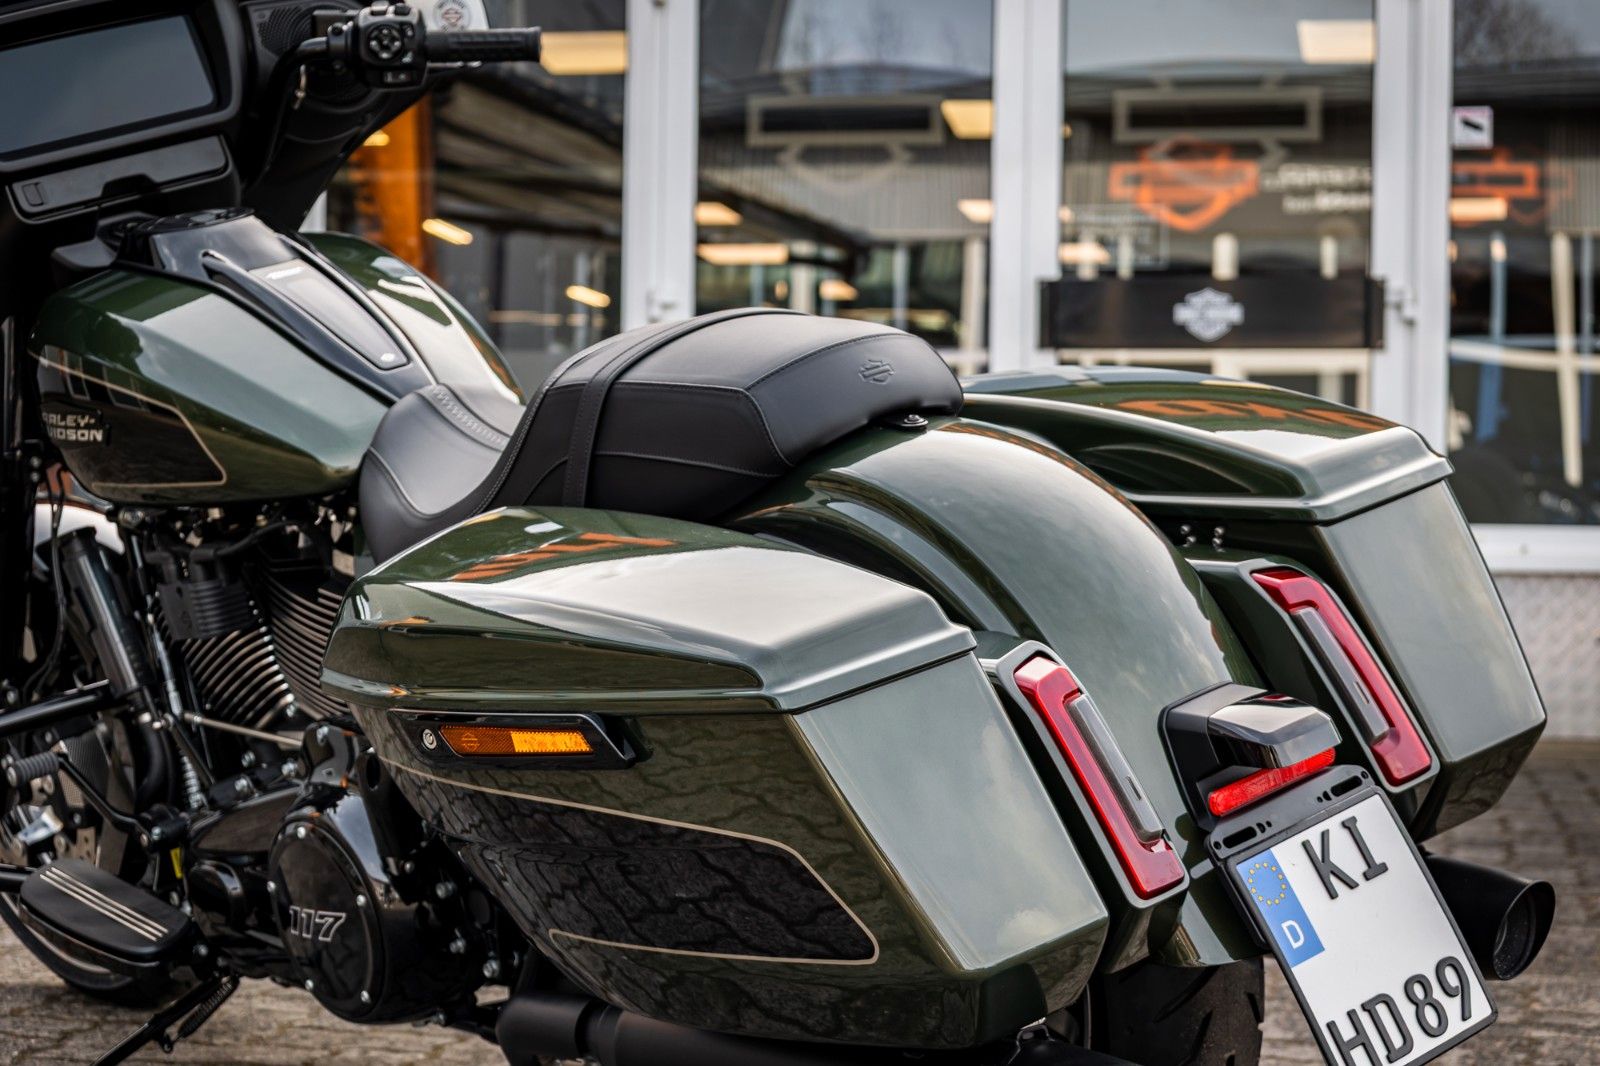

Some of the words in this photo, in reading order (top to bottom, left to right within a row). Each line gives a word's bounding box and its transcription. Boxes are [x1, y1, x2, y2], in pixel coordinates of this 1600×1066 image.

[1301, 816, 1389, 900] KI
[289, 905, 347, 942] 117
[1281, 919, 1305, 949] D
